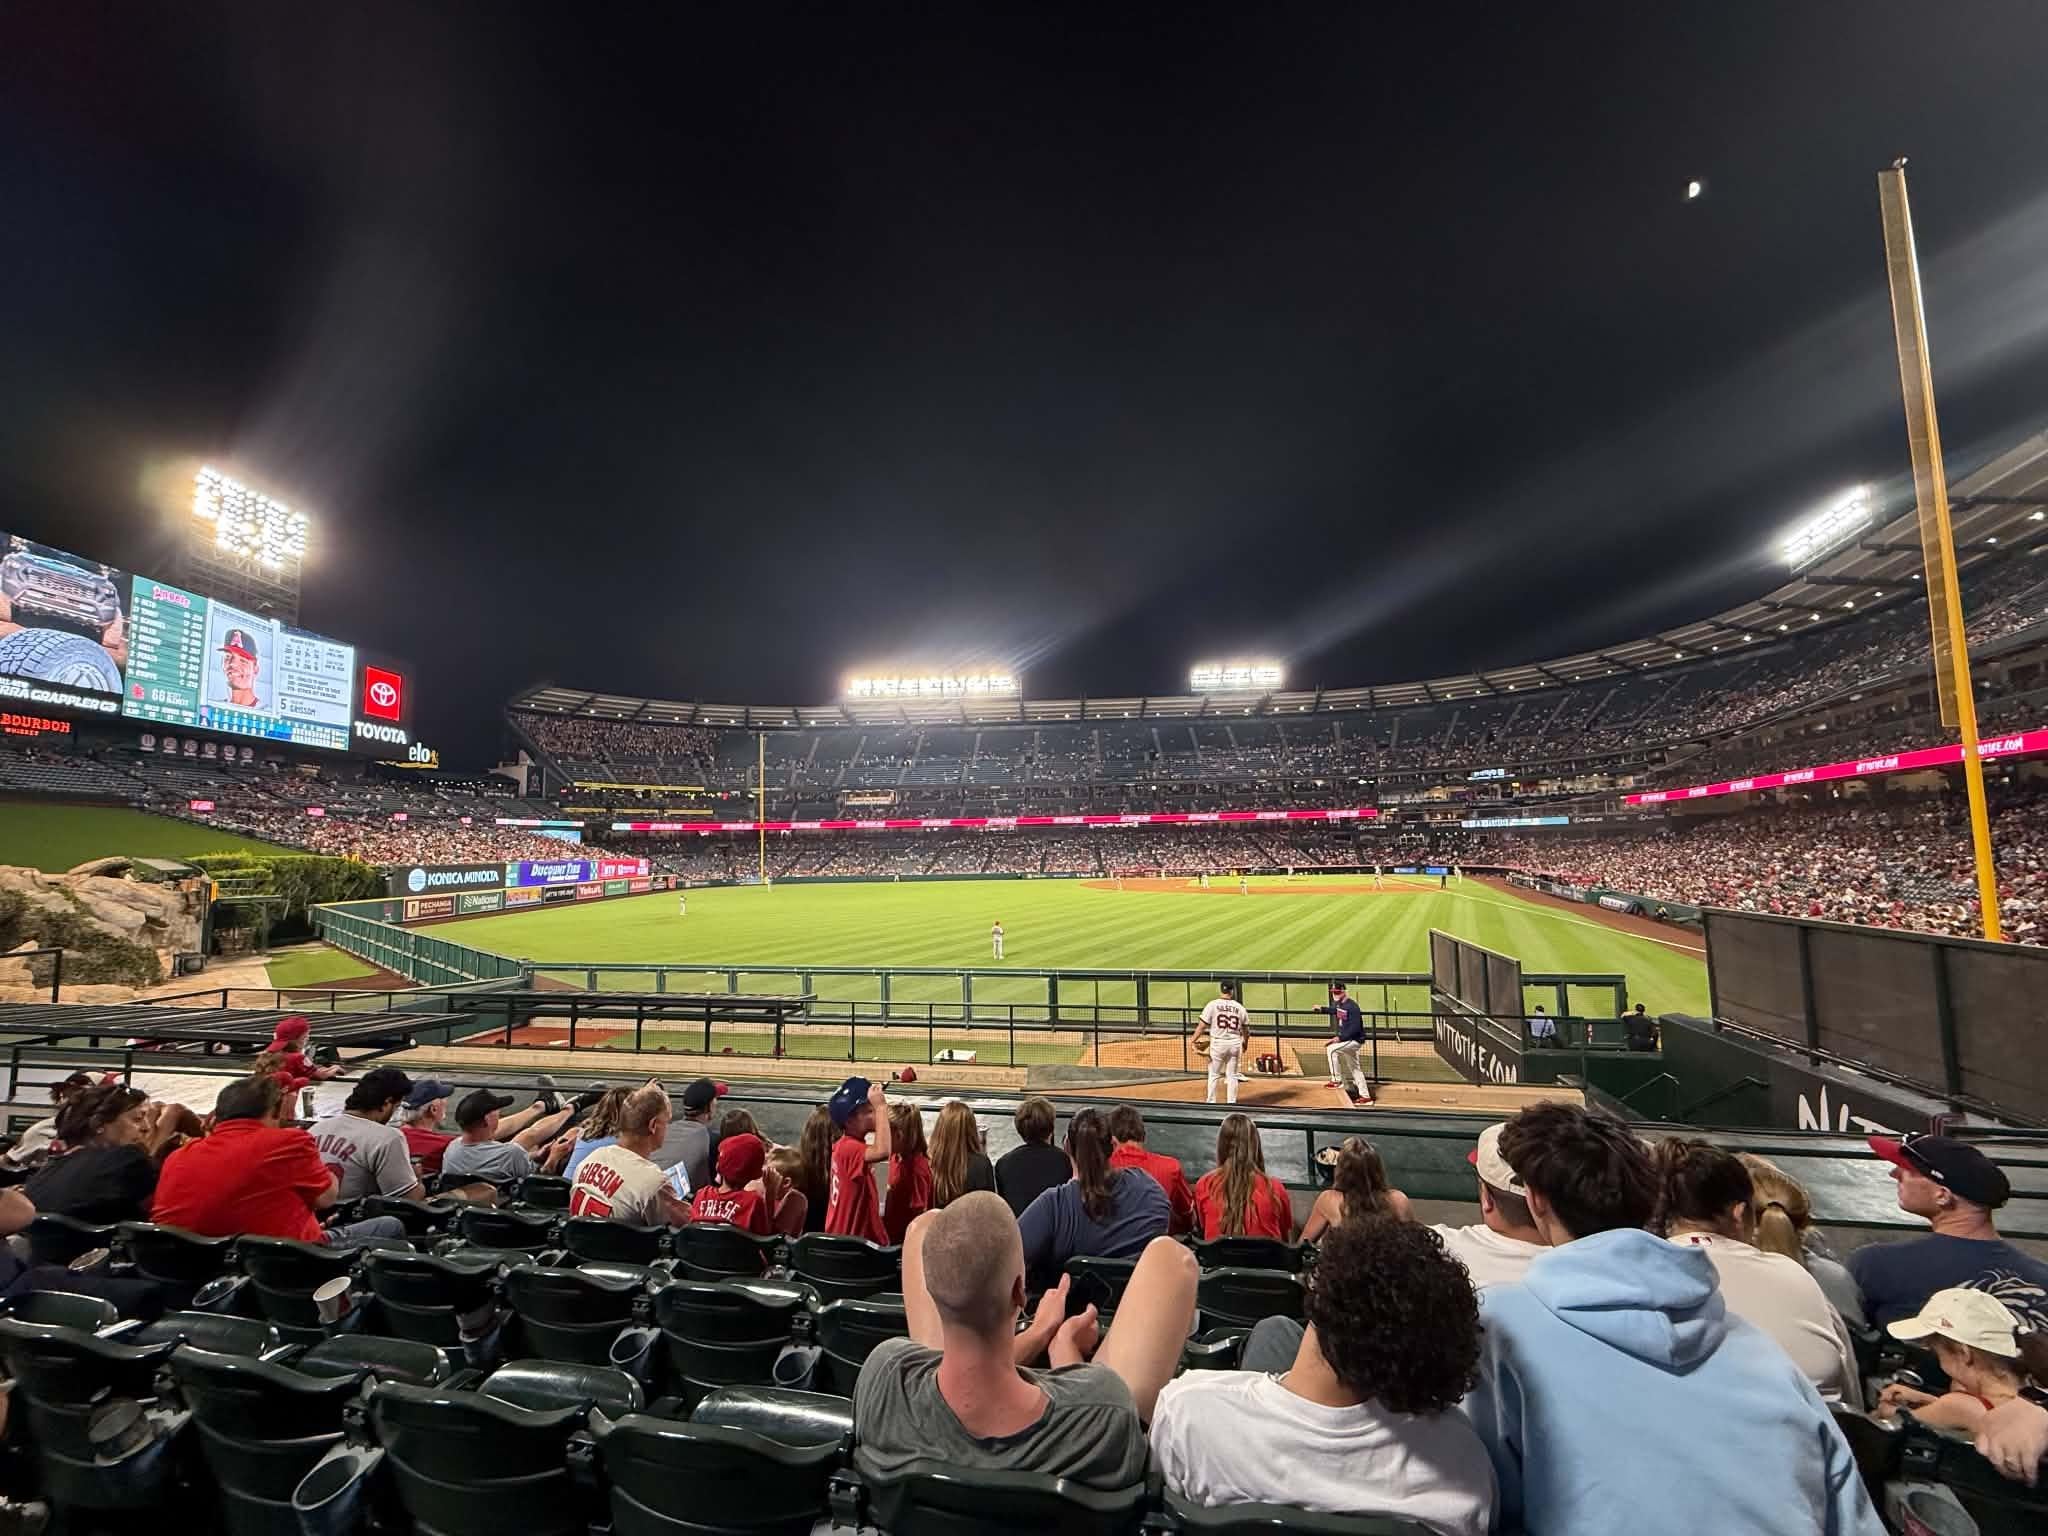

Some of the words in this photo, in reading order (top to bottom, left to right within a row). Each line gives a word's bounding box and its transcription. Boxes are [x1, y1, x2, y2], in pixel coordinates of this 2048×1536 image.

[31, 689, 99, 710] GRAPPLER
[280, 698, 287, 710] 5
[0, 713, 71, 733] BOURBON
[354, 720, 407, 744] TOYOTA
[409, 742, 431, 762] elo
[427, 872, 463, 886] KONICA
[464, 870, 499, 884] MINOLTA
[1217, 1014, 1239, 1030] 63
[578, 1162, 624, 1198] GIBSON
[699, 1199, 741, 1222] FREESE
